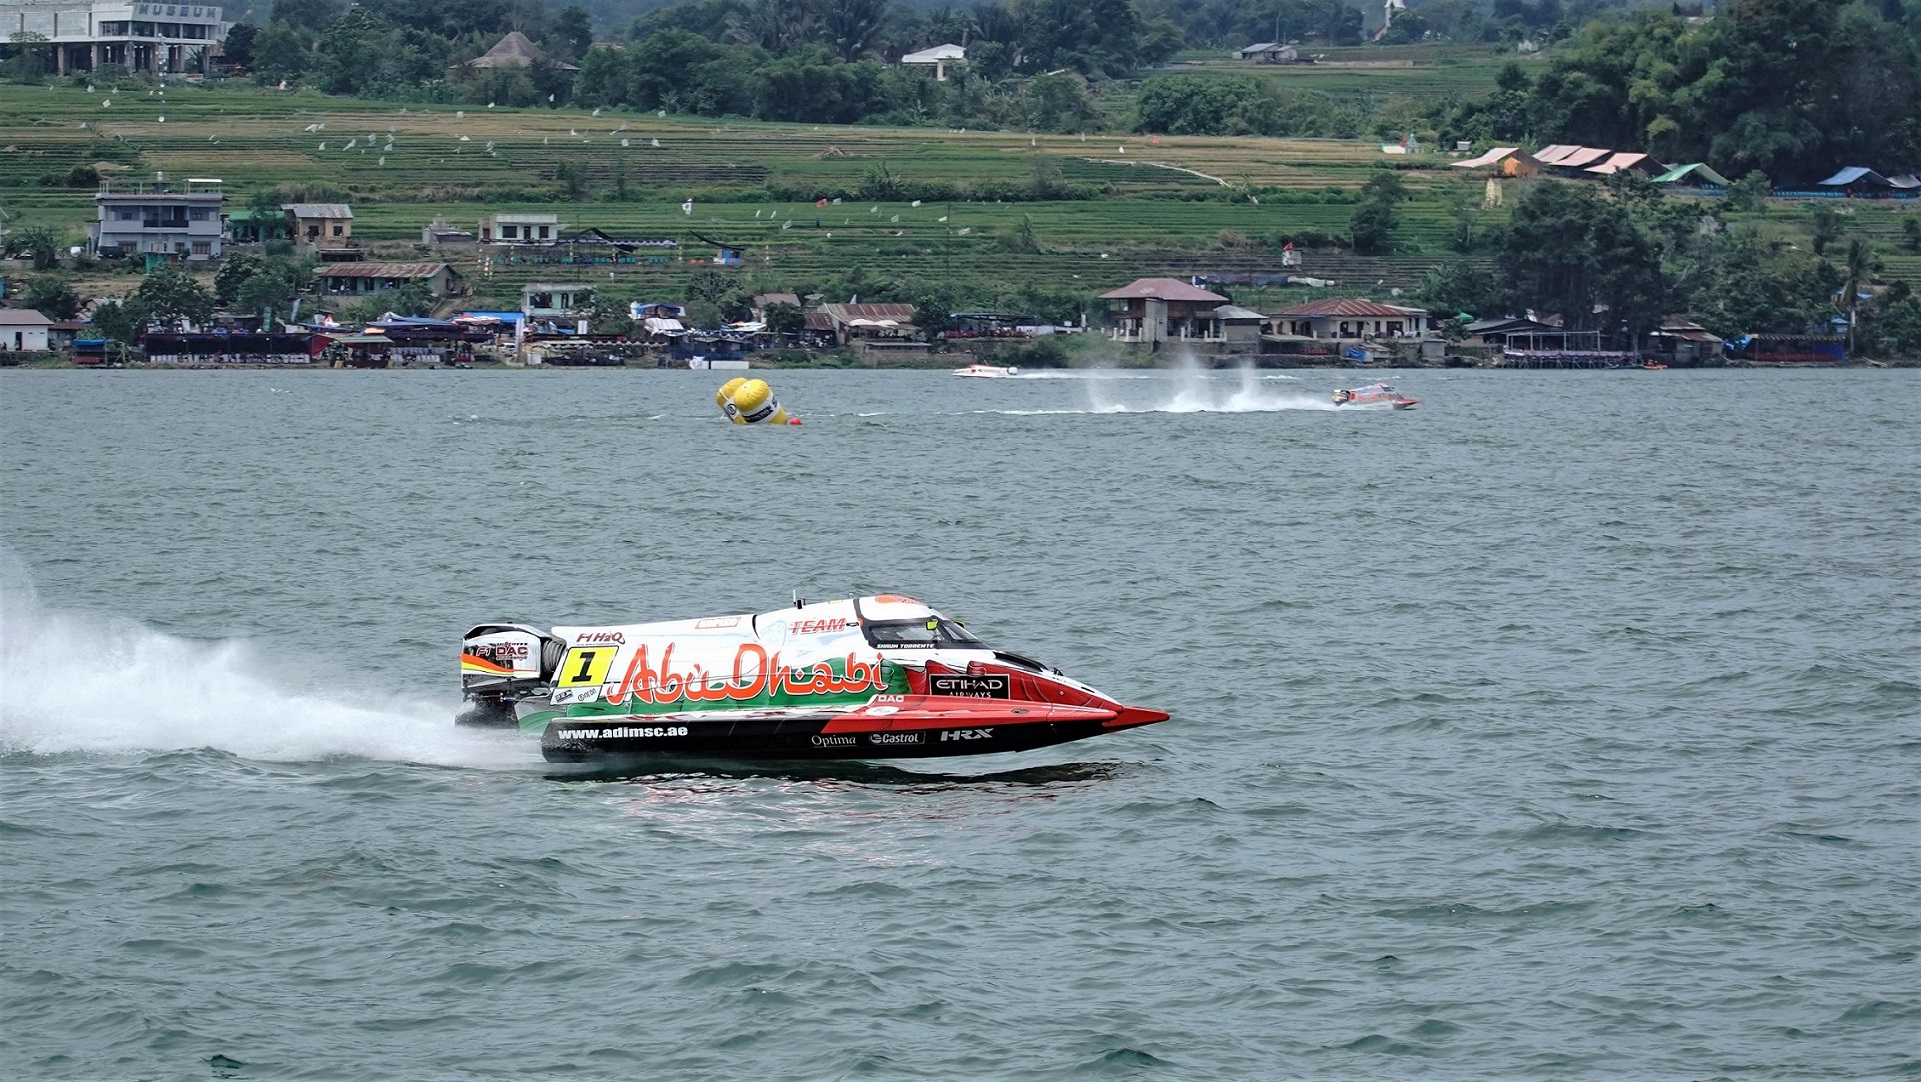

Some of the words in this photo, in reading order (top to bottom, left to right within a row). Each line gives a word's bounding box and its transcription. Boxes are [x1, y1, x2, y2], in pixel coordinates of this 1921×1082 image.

[138, 4, 217, 18] MUSEUM
[790, 618, 846, 634] TEAM
[476, 648, 491, 656] F1
[496, 646, 528, 655] DAC
[571, 651, 596, 683] 1
[722, 643, 889, 702] Dhabi
[936, 679, 1003, 690] ETIHAD
[878, 694, 904, 702] DAC
[558, 726, 688, 740] www.adimsc.ae
[882, 732, 919, 744] Castrol
[940, 728, 994, 741] HRX
[811, 734, 857, 747] Optima
